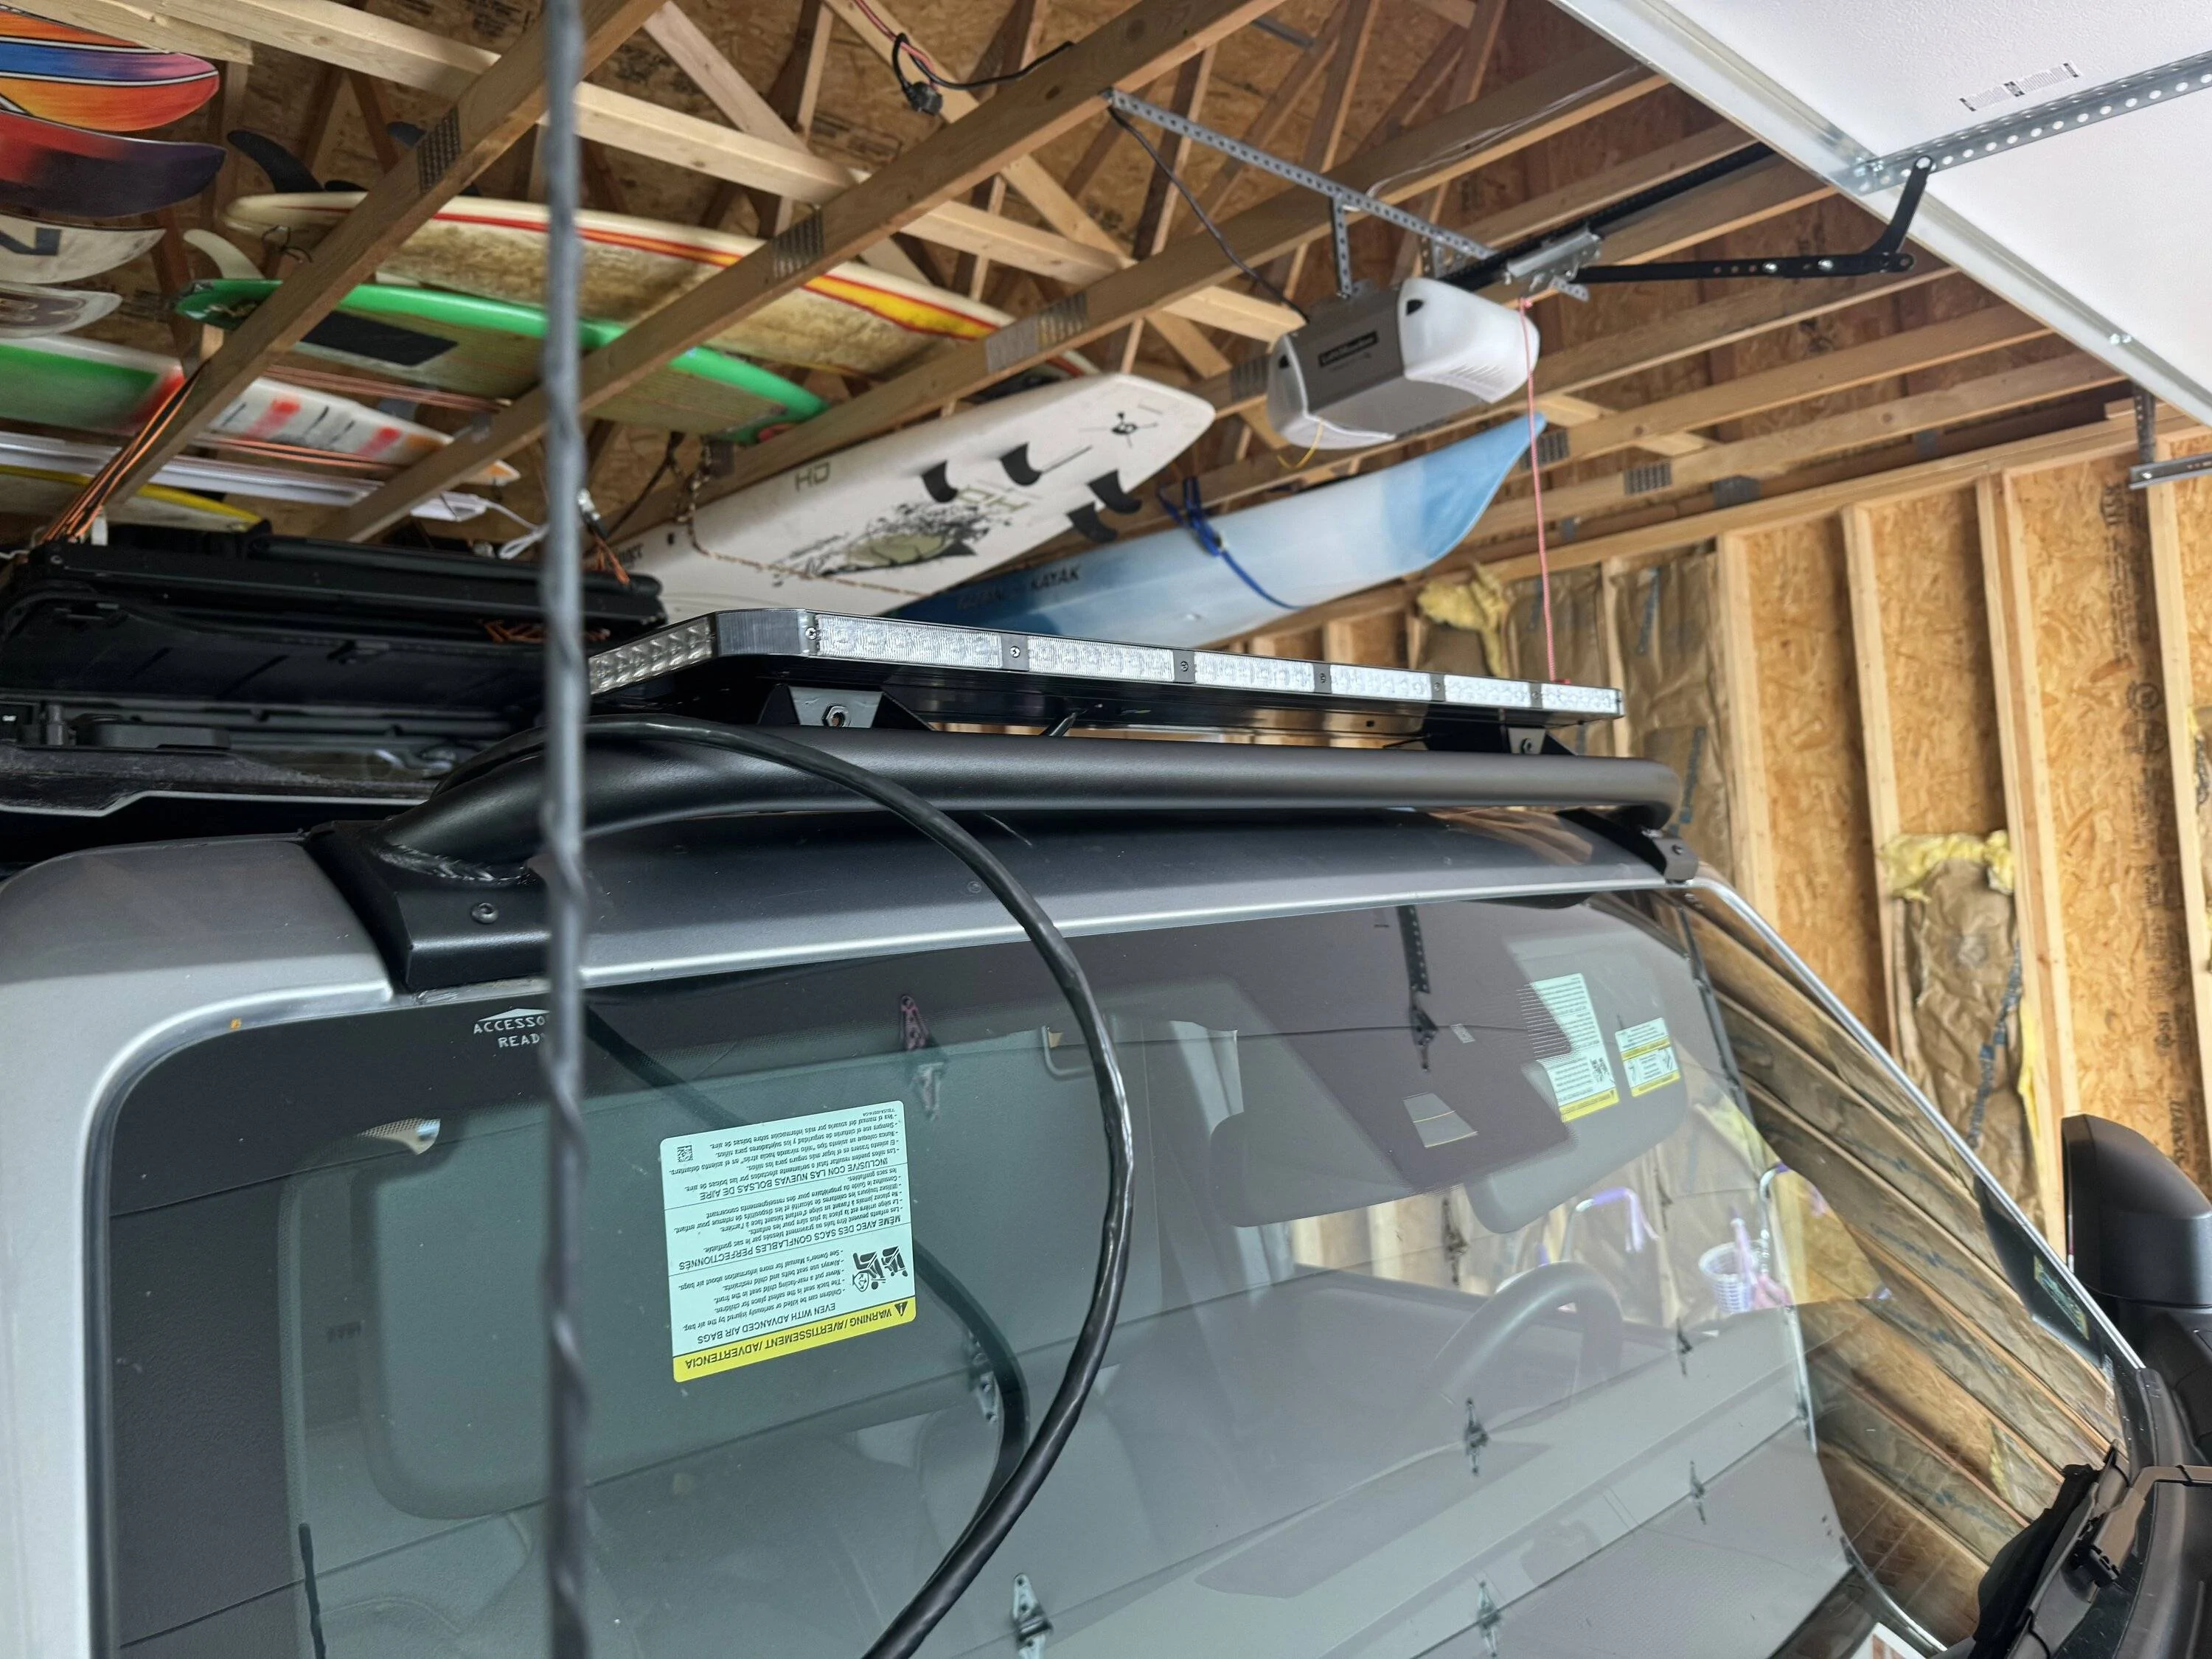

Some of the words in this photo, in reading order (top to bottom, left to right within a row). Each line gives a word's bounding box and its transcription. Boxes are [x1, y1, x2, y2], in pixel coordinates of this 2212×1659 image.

[473, 1015, 548, 1034] ACCESSO
[498, 1033, 544, 1048] READ
[810, 1169, 826, 1180] LAS
[828, 1165, 846, 1176] CON
[774, 1172, 808, 1186] NUEVAS
[722, 1186, 735, 1197] DE
[737, 1179, 773, 1194] BOLSAS
[699, 1189, 721, 1201] AIRE
[838, 1224, 855, 1236] DES
[855, 1220, 877, 1231] AVEC
[813, 1228, 837, 1241] SACS
[755, 1234, 813, 1253] GONFLABLES
[679, 1247, 754, 1270] PERFECTIONNÉS
[790, 1309, 813, 1321] WITH
[814, 1302, 836, 1315] EVEN
[742, 1314, 790, 1333] ADVANCED
[849, 1309, 892, 1326] WARNING
[697, 1330, 723, 1344] BAGS
[725, 1326, 741, 1338] AIR
[765, 1320, 848, 1349] /AVERTISSEMENT
[685, 1341, 762, 1368] /ADVERTENCIA
